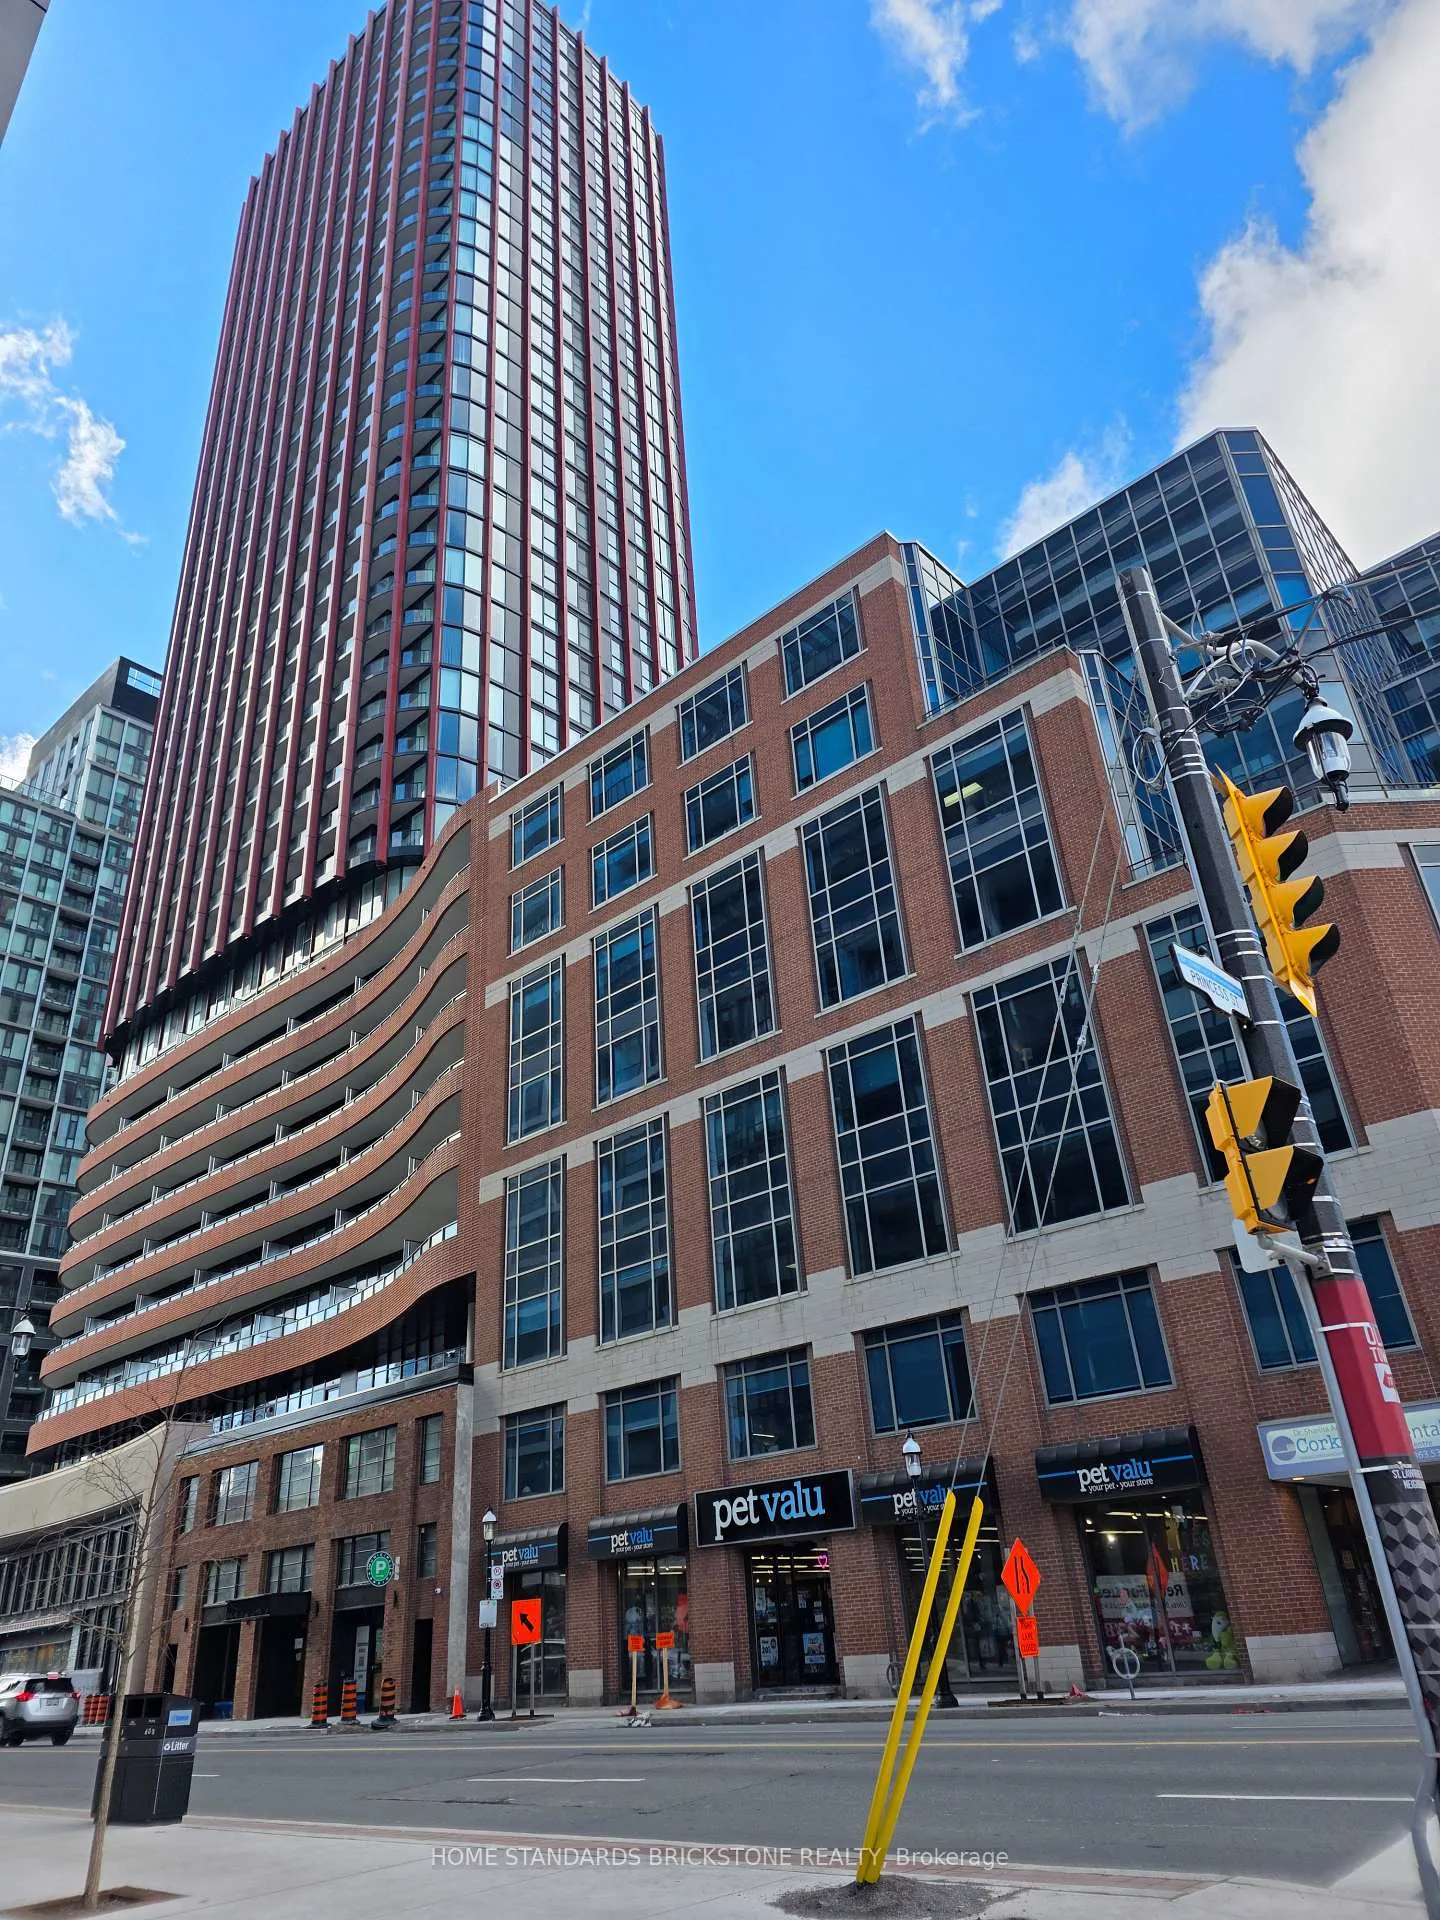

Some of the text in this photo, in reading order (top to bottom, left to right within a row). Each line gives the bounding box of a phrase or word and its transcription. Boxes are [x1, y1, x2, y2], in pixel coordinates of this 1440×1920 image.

[1190, 969, 1230, 1002] PRINCESS
[1296, 1421, 1440, 1453] Cork nta
[1076, 1458, 1153, 1492] pet valu
[1088, 1478, 1154, 1494] your pet your store
[713, 1480, 826, 1541] pet valu
[892, 1488, 917, 1515] pet
[610, 1527, 654, 1553] pet valu
[375, 1560, 387, 1575] P
[502, 1544, 539, 1567] pet valu
[170, 1741, 190, 1752] Litter
